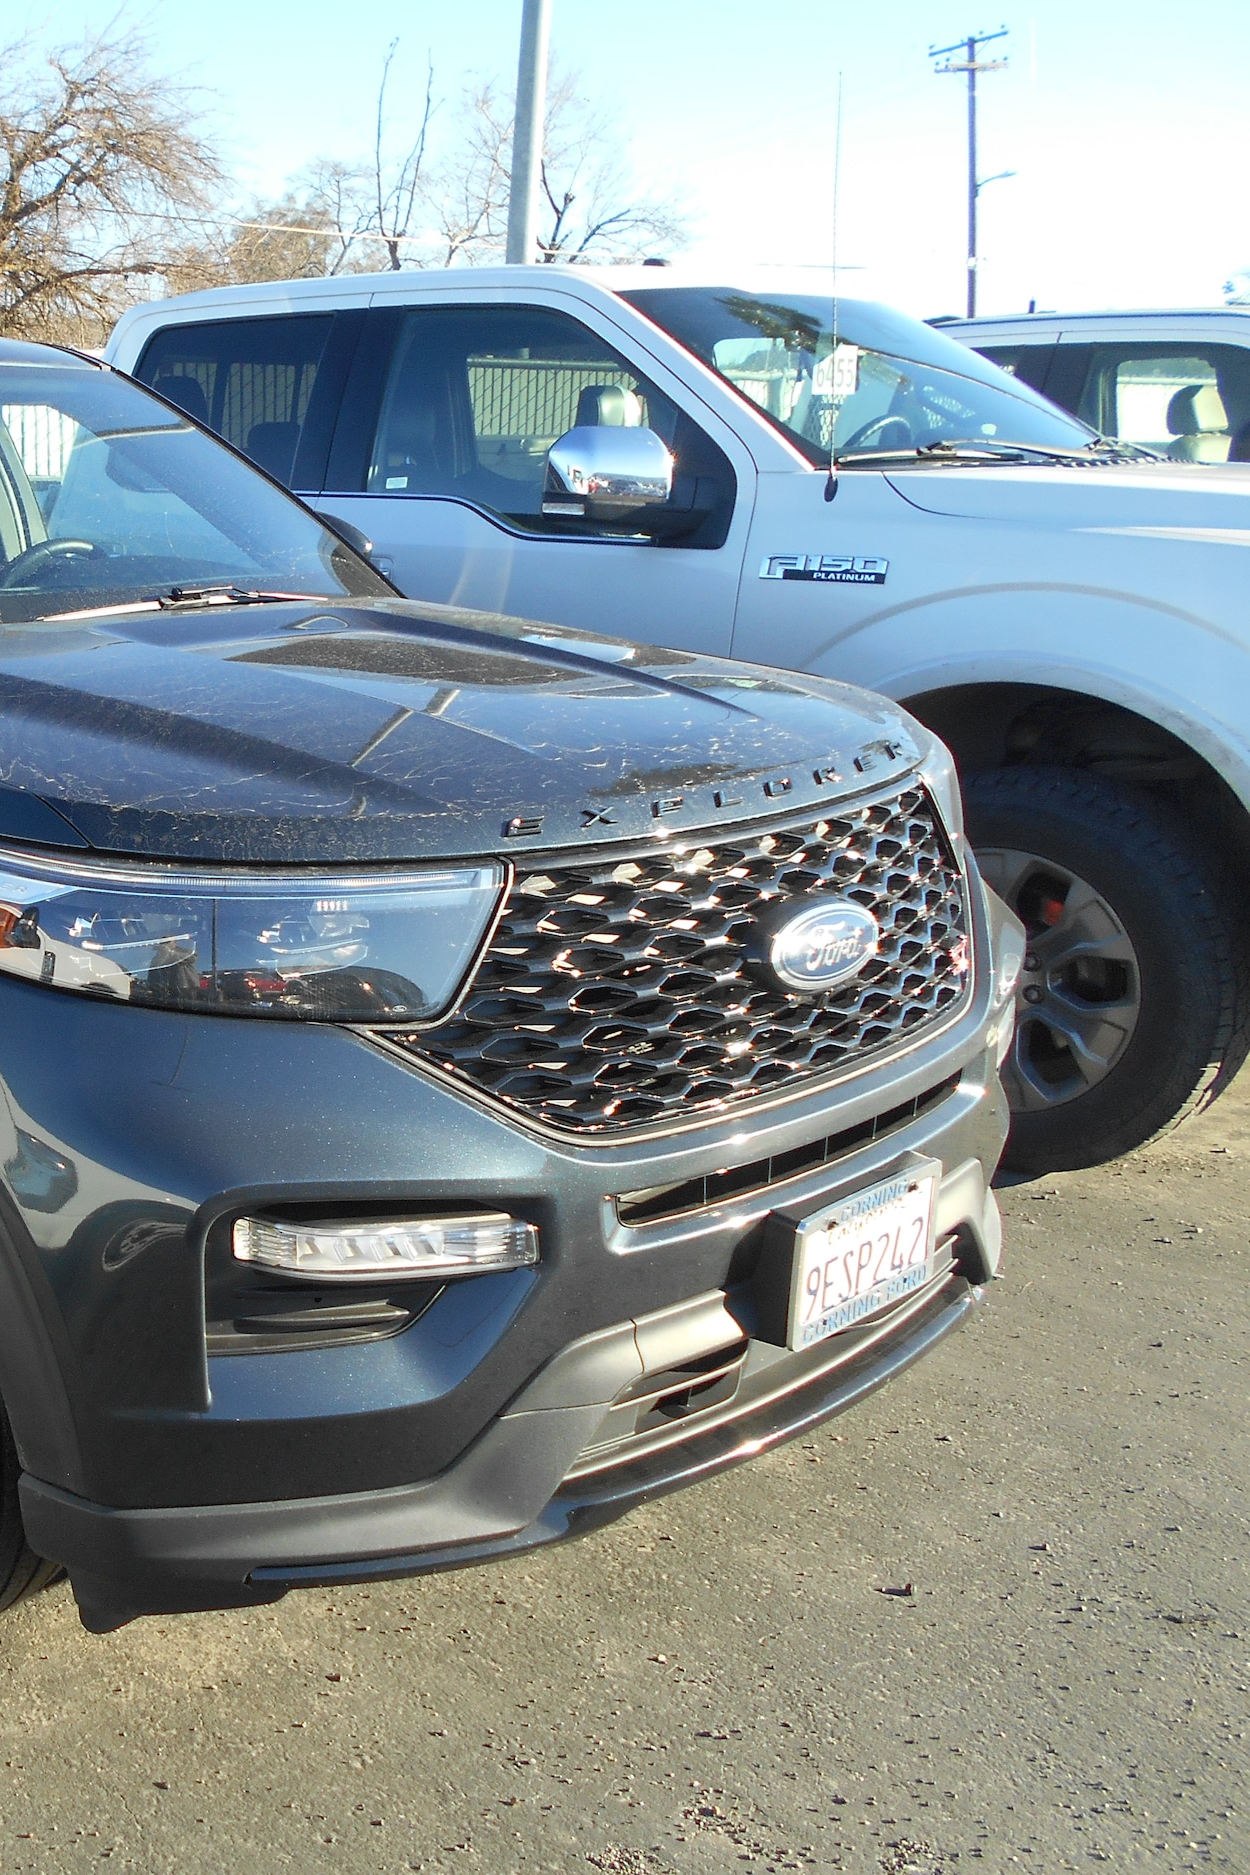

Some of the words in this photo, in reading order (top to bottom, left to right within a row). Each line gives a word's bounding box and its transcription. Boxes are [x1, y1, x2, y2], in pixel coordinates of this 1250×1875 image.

[813, 571, 876, 582] PLATINUM
[501, 742, 906, 838] EXPLORER
[804, 920, 862, 972] Ford
[840, 1179, 910, 1223] CORNING
[806, 1216, 925, 1321] 9ESP242
[803, 1287, 880, 1345] CORNING
[886, 1264, 927, 1301] FORD
